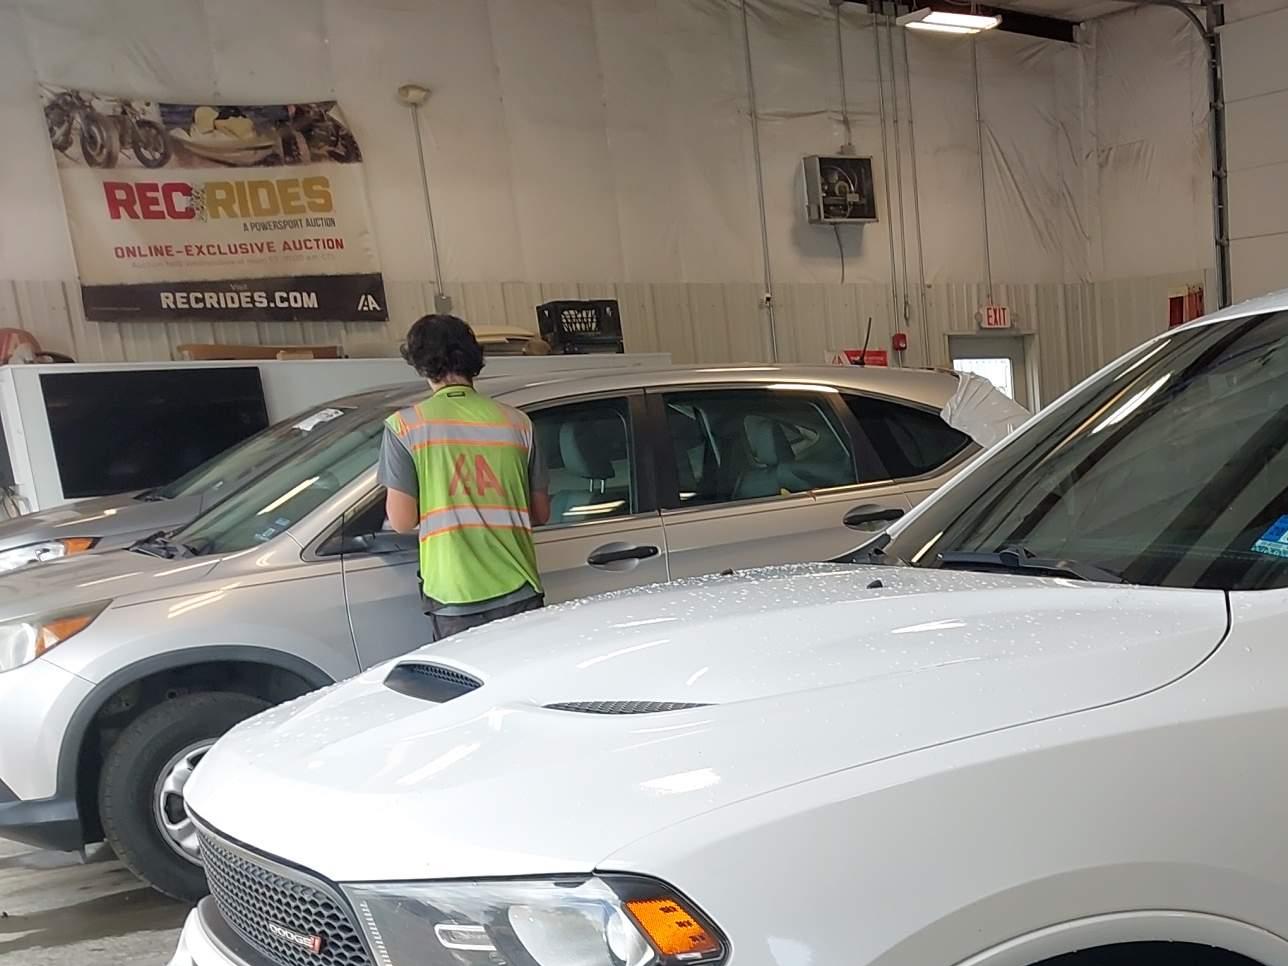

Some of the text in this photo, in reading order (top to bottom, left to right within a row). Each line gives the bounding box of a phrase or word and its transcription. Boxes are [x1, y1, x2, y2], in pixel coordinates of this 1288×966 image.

[103, 176, 333, 220] REC RIDES
[243, 217, 336, 232] A POWERSPORT AUCTION
[114, 238, 344, 259] ONLINE-EXCLUSIVE AUCTION
[160, 291, 318, 310] RECRIDES.COM
[986, 307, 1007, 327] EXIT
